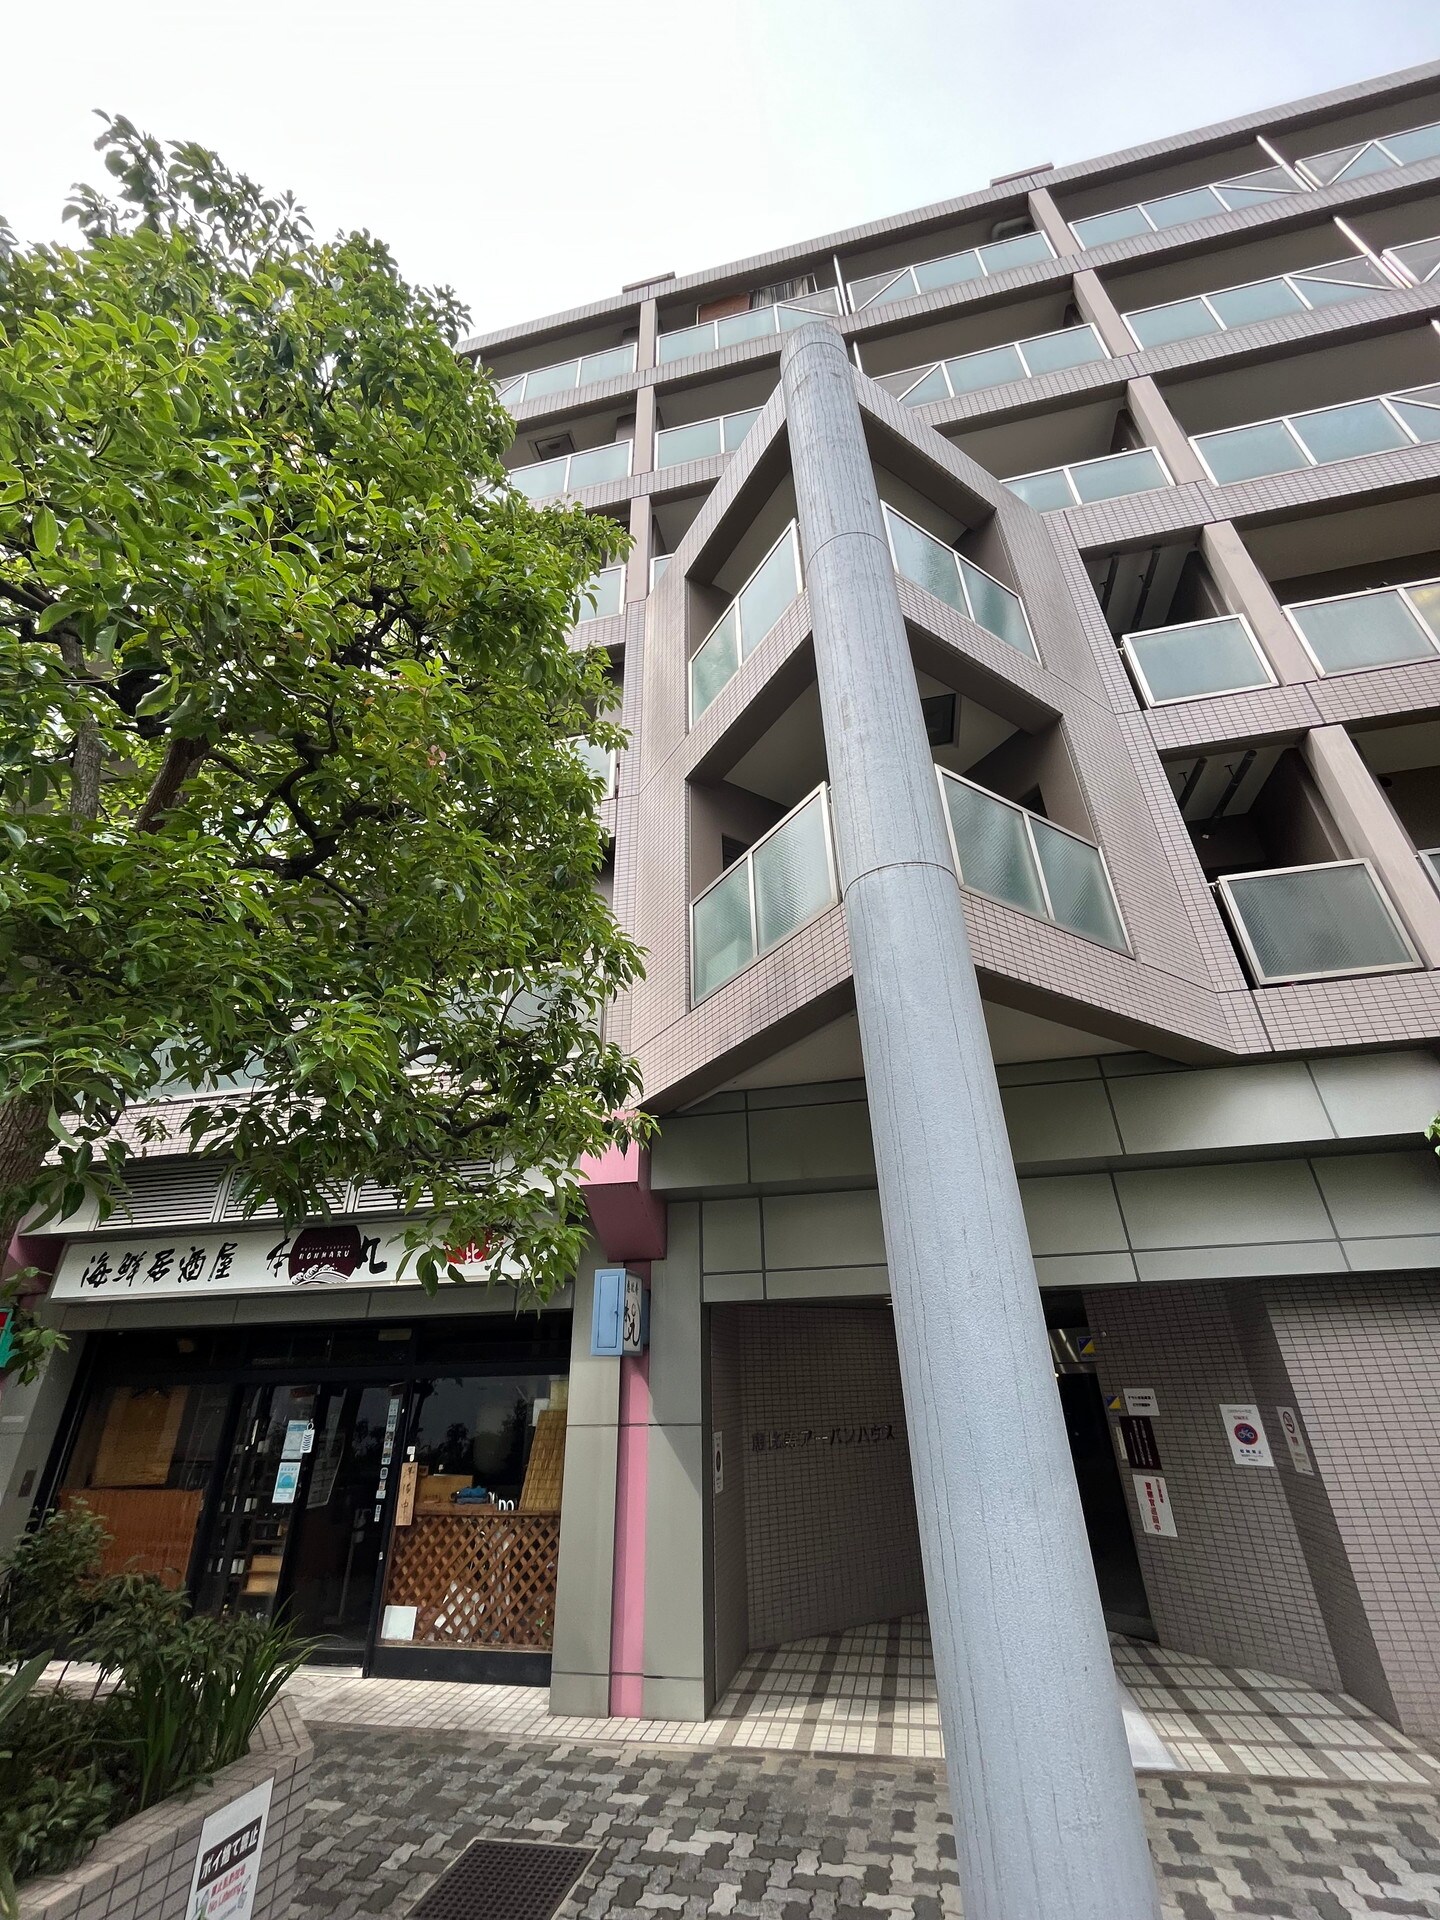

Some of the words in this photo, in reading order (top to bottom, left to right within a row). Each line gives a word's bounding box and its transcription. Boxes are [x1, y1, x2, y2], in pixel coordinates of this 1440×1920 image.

[81, 1242, 238, 1288] 海鮮居酒屋
[200, 1825, 259, 1880] ポイ捨て禁止
